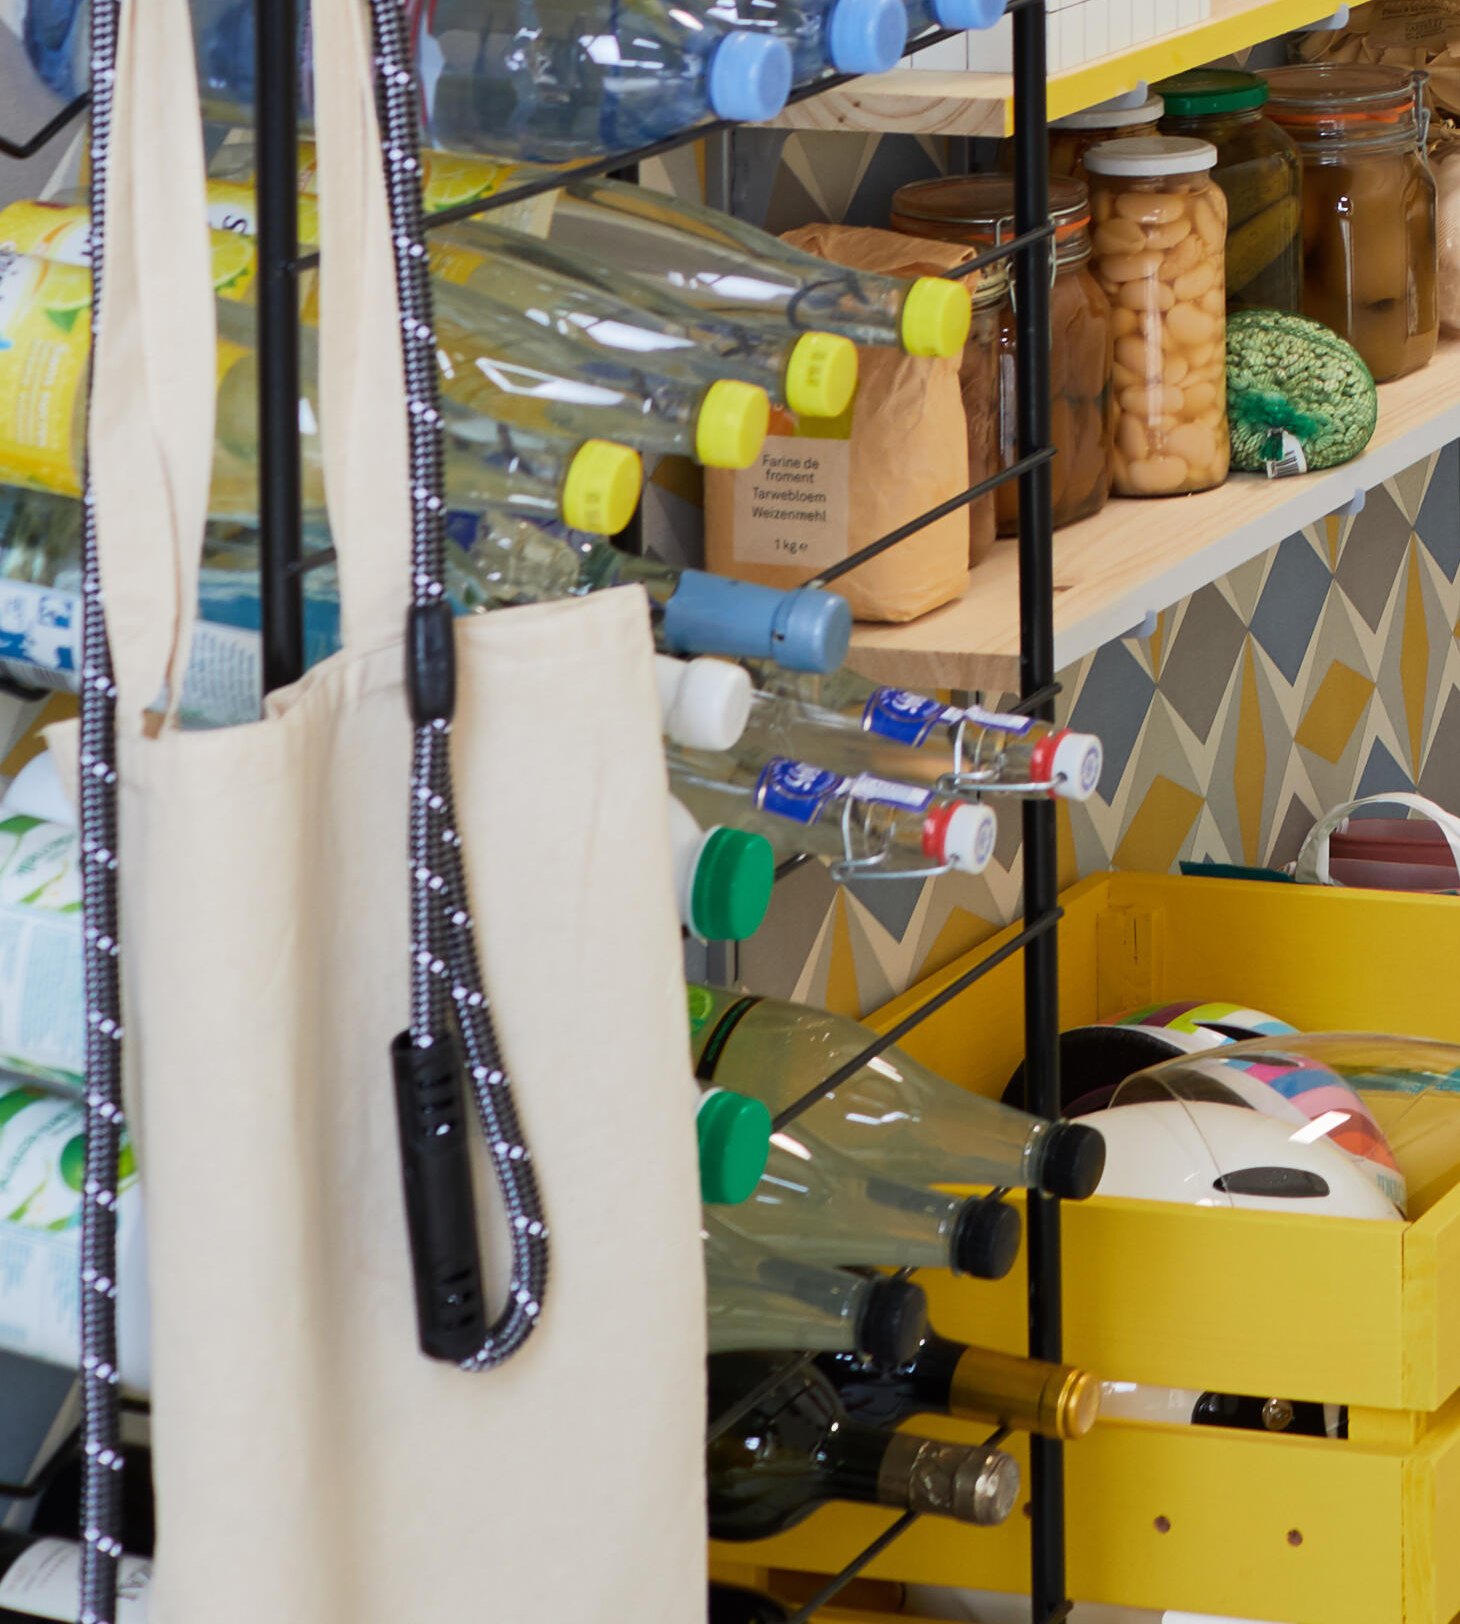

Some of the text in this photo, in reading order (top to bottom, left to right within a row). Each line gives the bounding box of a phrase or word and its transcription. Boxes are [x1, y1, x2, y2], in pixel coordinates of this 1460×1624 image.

[761, 454, 820, 471] Farine de
[765, 468, 815, 484] froment
[752, 485, 827, 503] Tarwebloem
[751, 505, 827, 523] Weizenmehl
[783, 539, 798, 555] kg
